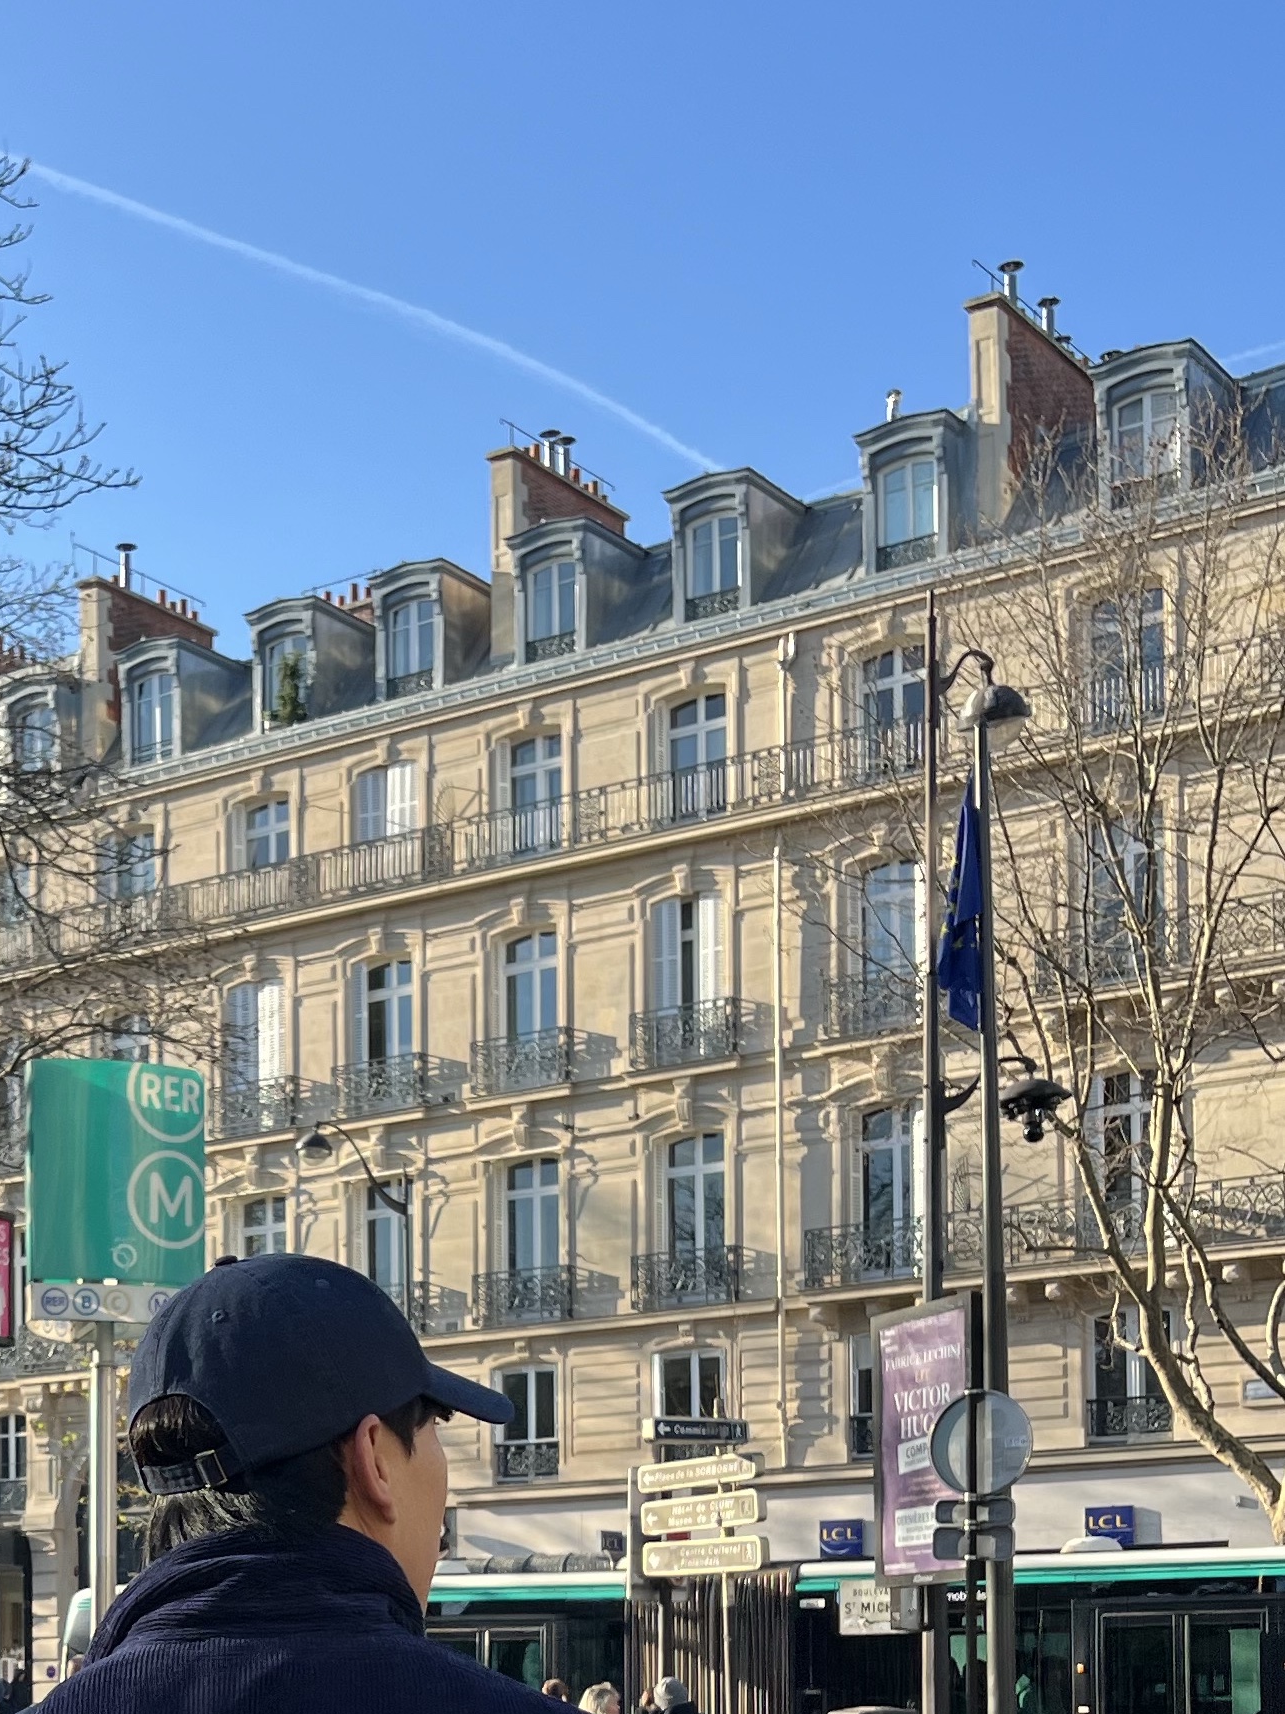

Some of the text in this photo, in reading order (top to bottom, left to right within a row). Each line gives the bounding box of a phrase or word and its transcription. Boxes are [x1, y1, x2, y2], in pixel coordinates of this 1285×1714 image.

[140, 1072, 201, 1115] RER
[149, 1171, 194, 1227] M
[893, 1382, 951, 1413] VICTOR
[899, 1412, 935, 1440] HUG
[695, 1461, 738, 1478] SORBONNE
[1088, 1514, 1128, 1530] LCL
[822, 1527, 858, 1542] LCL
[852, 1587, 889, 1597] BOULEVA
[860, 1601, 892, 1615] MICH
